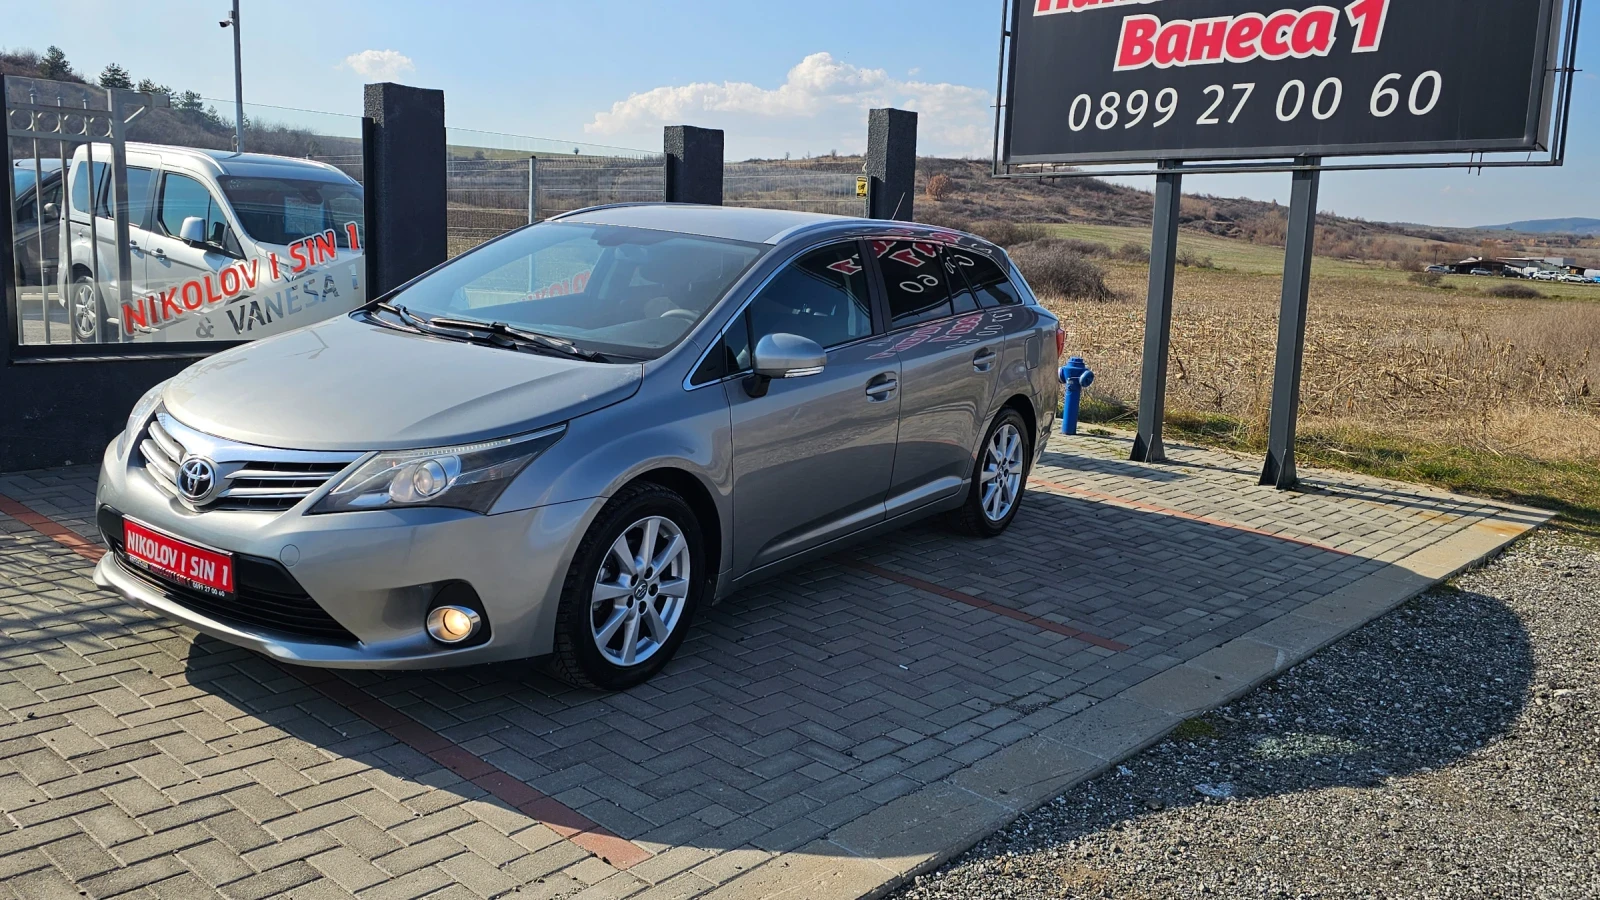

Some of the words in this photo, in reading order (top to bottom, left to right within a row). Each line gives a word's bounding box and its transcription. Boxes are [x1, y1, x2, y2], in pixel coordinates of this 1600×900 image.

[1113, 7, 1339, 71] Ванеса
[1346, 0, 1388, 53] 1
[1068, 87, 1179, 131] 0899
[1196, 82, 1255, 125] 27
[1275, 76, 1342, 121] 00
[1369, 70, 1442, 117] 60
[121, 257, 259, 335] NIKOLOV
[289, 231, 337, 274] SIN
[345, 221, 360, 251] 1
[195, 317, 215, 339] &
[226, 273, 340, 335] VANESA
[127, 530, 177, 568] NIKOLOV
[189, 556, 216, 582] SIN
[222, 565, 229, 586] 1
